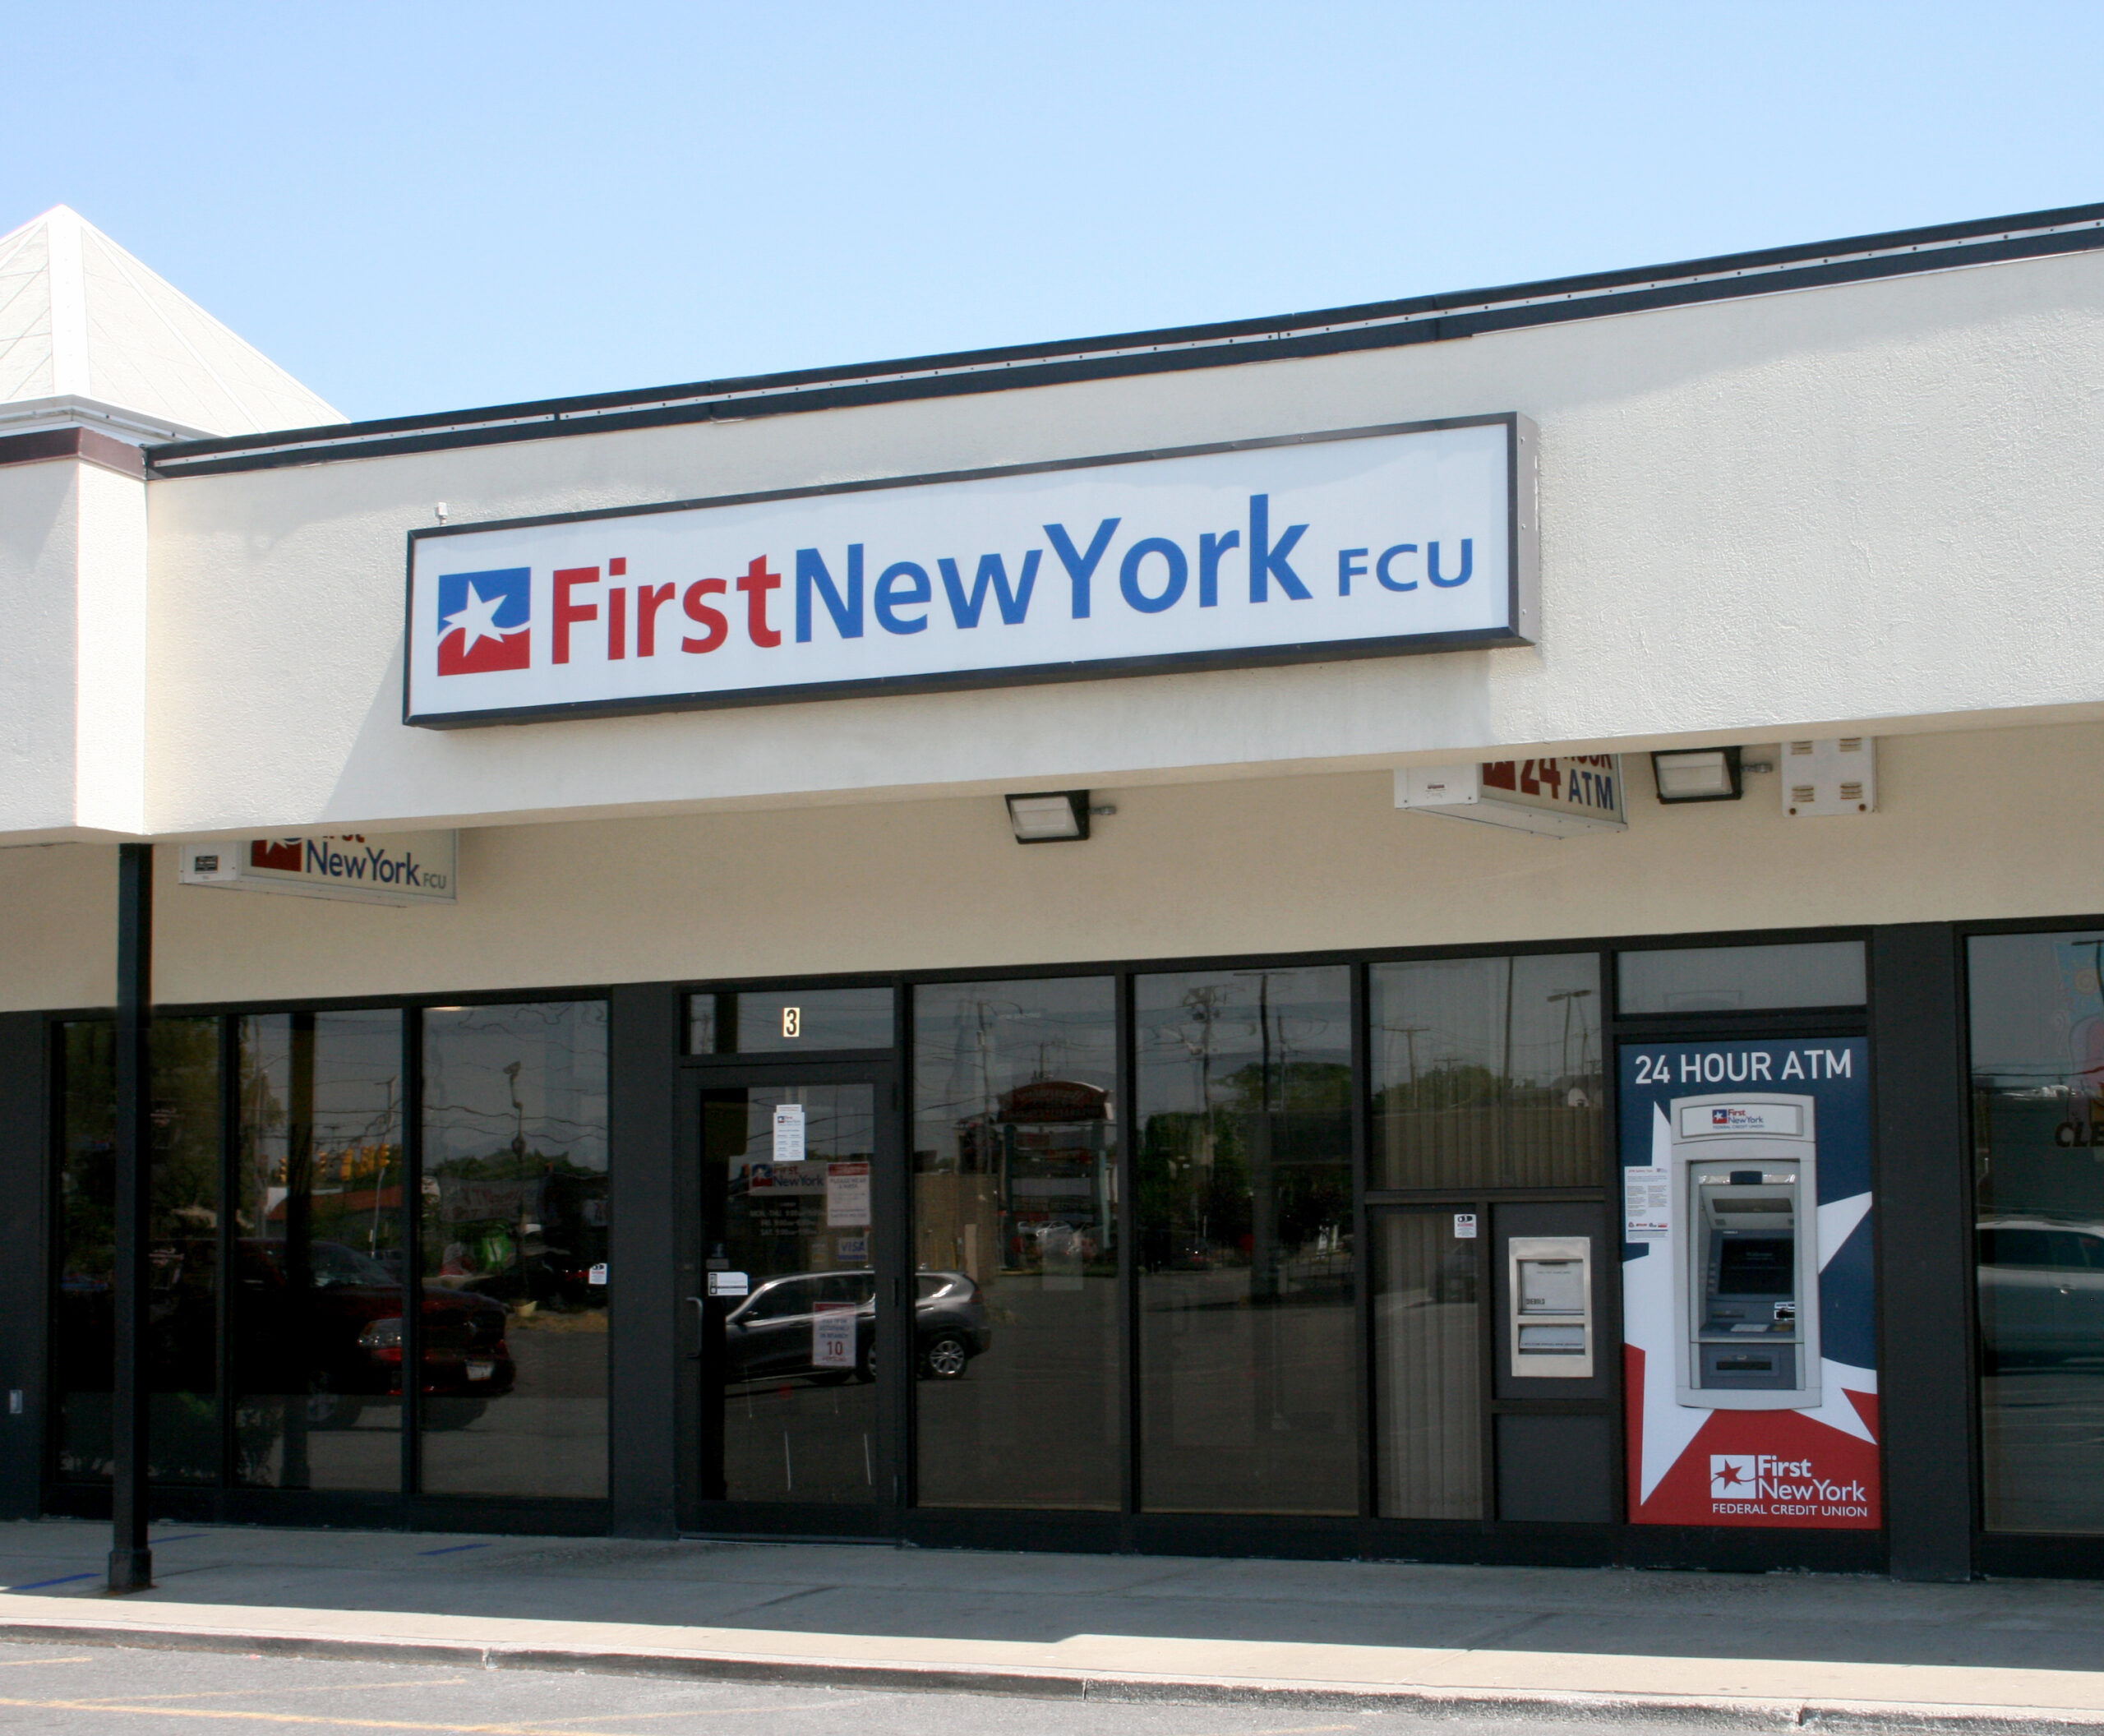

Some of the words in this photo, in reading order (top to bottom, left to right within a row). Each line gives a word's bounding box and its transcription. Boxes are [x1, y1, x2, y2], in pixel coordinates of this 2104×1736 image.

[1338, 538, 1473, 597] FCU
[1520, 758, 1561, 799] 24
[1569, 769, 1613, 810] ATM
[422, 873, 447, 889] FCU
[786, 1009, 797, 1036] 3
[1635, 1055, 1670, 1084] 24
[1681, 1052, 1771, 1083] HOUR
[1781, 1049, 1852, 1080] ATM
[1728, 1108, 1746, 1116] First
[841, 1241, 865, 1252] VISA
[827, 1341, 843, 1355] 10
[1758, 1455, 1811, 1477] First
[1712, 1503, 1767, 1514] FEDERAL
[1771, 1504, 1817, 1516] CREDIT
[1821, 1506, 1867, 1517] UNION
